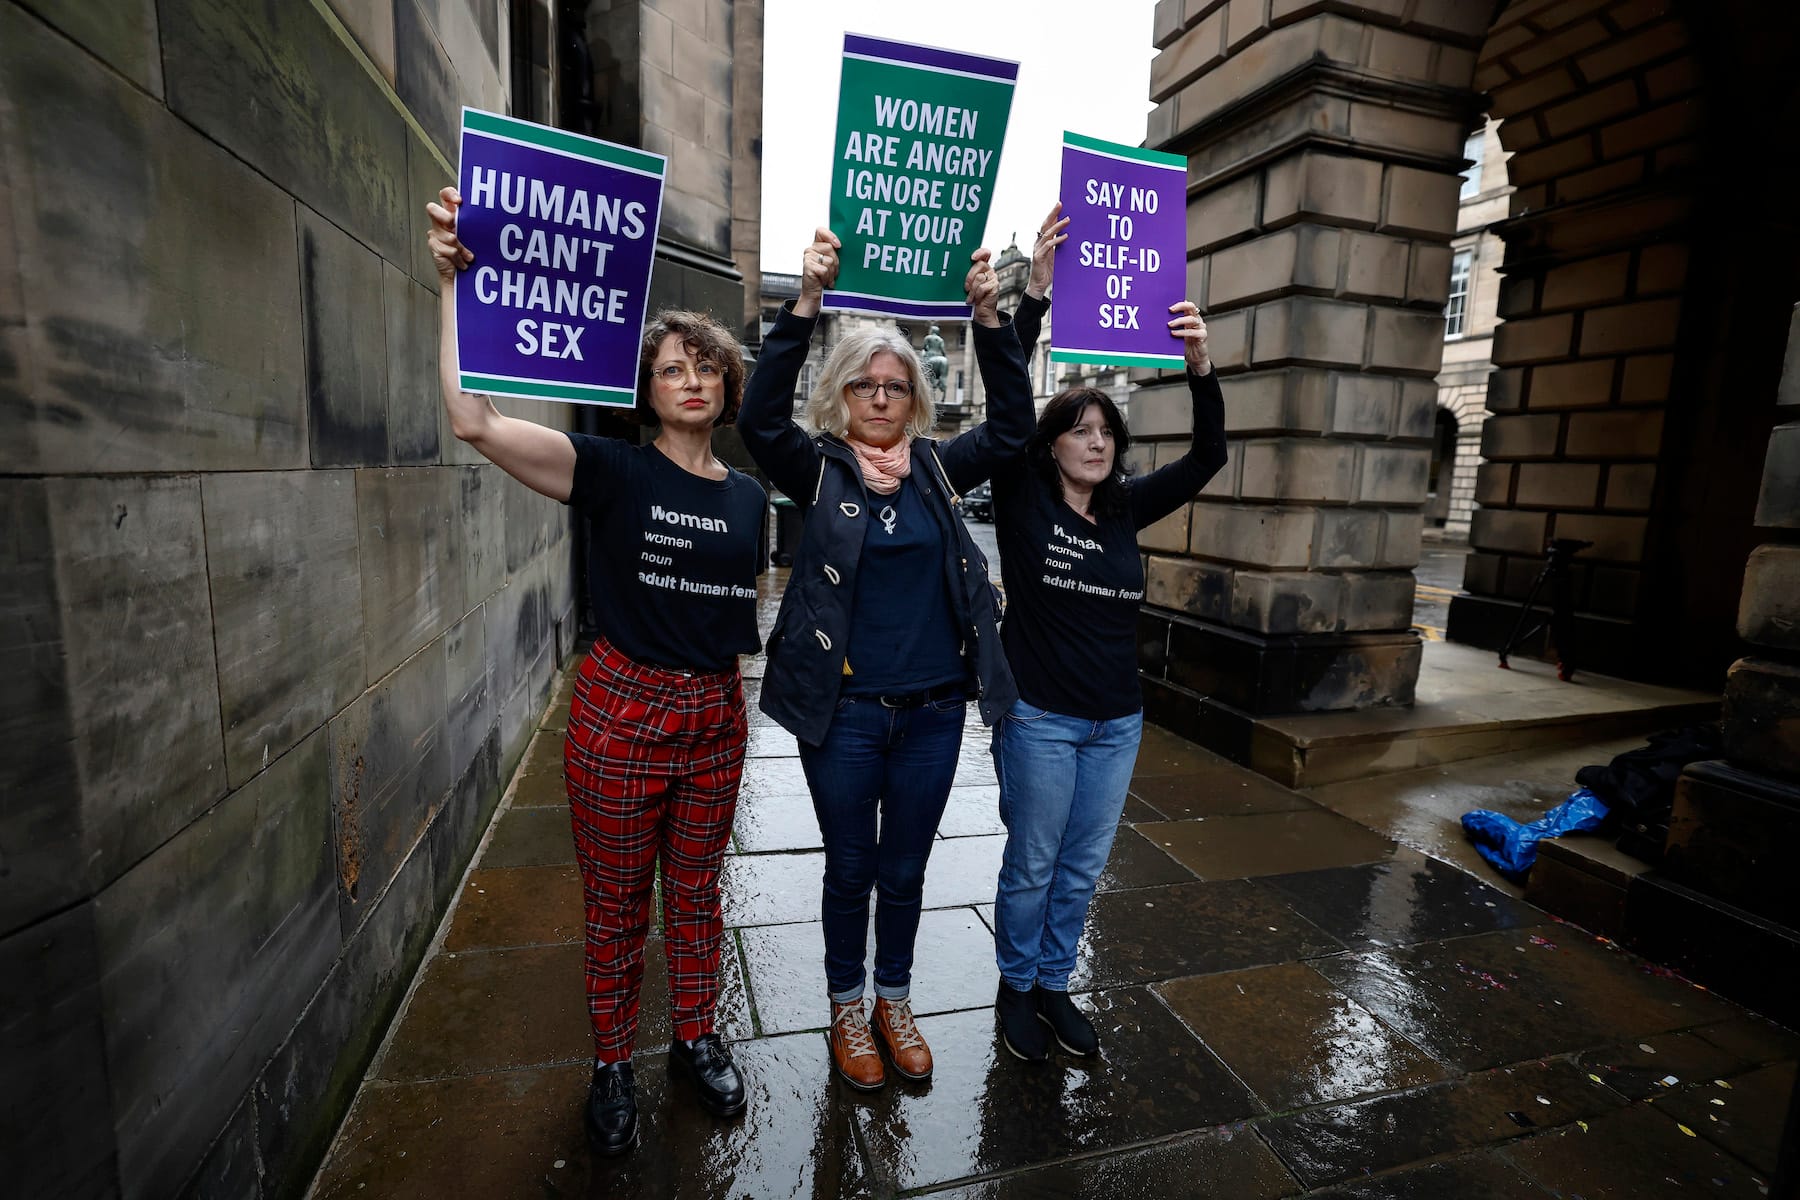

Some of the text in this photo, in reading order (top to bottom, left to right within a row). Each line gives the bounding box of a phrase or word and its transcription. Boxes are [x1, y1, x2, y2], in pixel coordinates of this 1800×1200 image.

[874, 95, 978, 140] WOMEN
[844, 131, 993, 178] ARE ANGRY
[470, 166, 646, 240] HUMANS
[845, 169, 982, 212] IGNORE US
[1085, 179, 1159, 214] SAY NO
[856, 207, 964, 245] AT YOUR
[1107, 214, 1133, 241] TO
[500, 223, 614, 277] CAN'T
[863, 243, 949, 277] PERIL !
[1079, 241, 1161, 273] SELF-ID
[474, 266, 628, 324] CHANGE
[1106, 274, 1133, 299] OF
[1098, 304, 1140, 330] SEX
[515, 319, 585, 361] SEX
[651, 505, 728, 533] Woman
[640, 551, 673, 566] noun
[1045, 557, 1072, 571] noun
[638, 571, 677, 590] adult
[679, 577, 729, 597] human
[1042, 574, 1077, 590] adult
[1078, 581, 1116, 598] human
